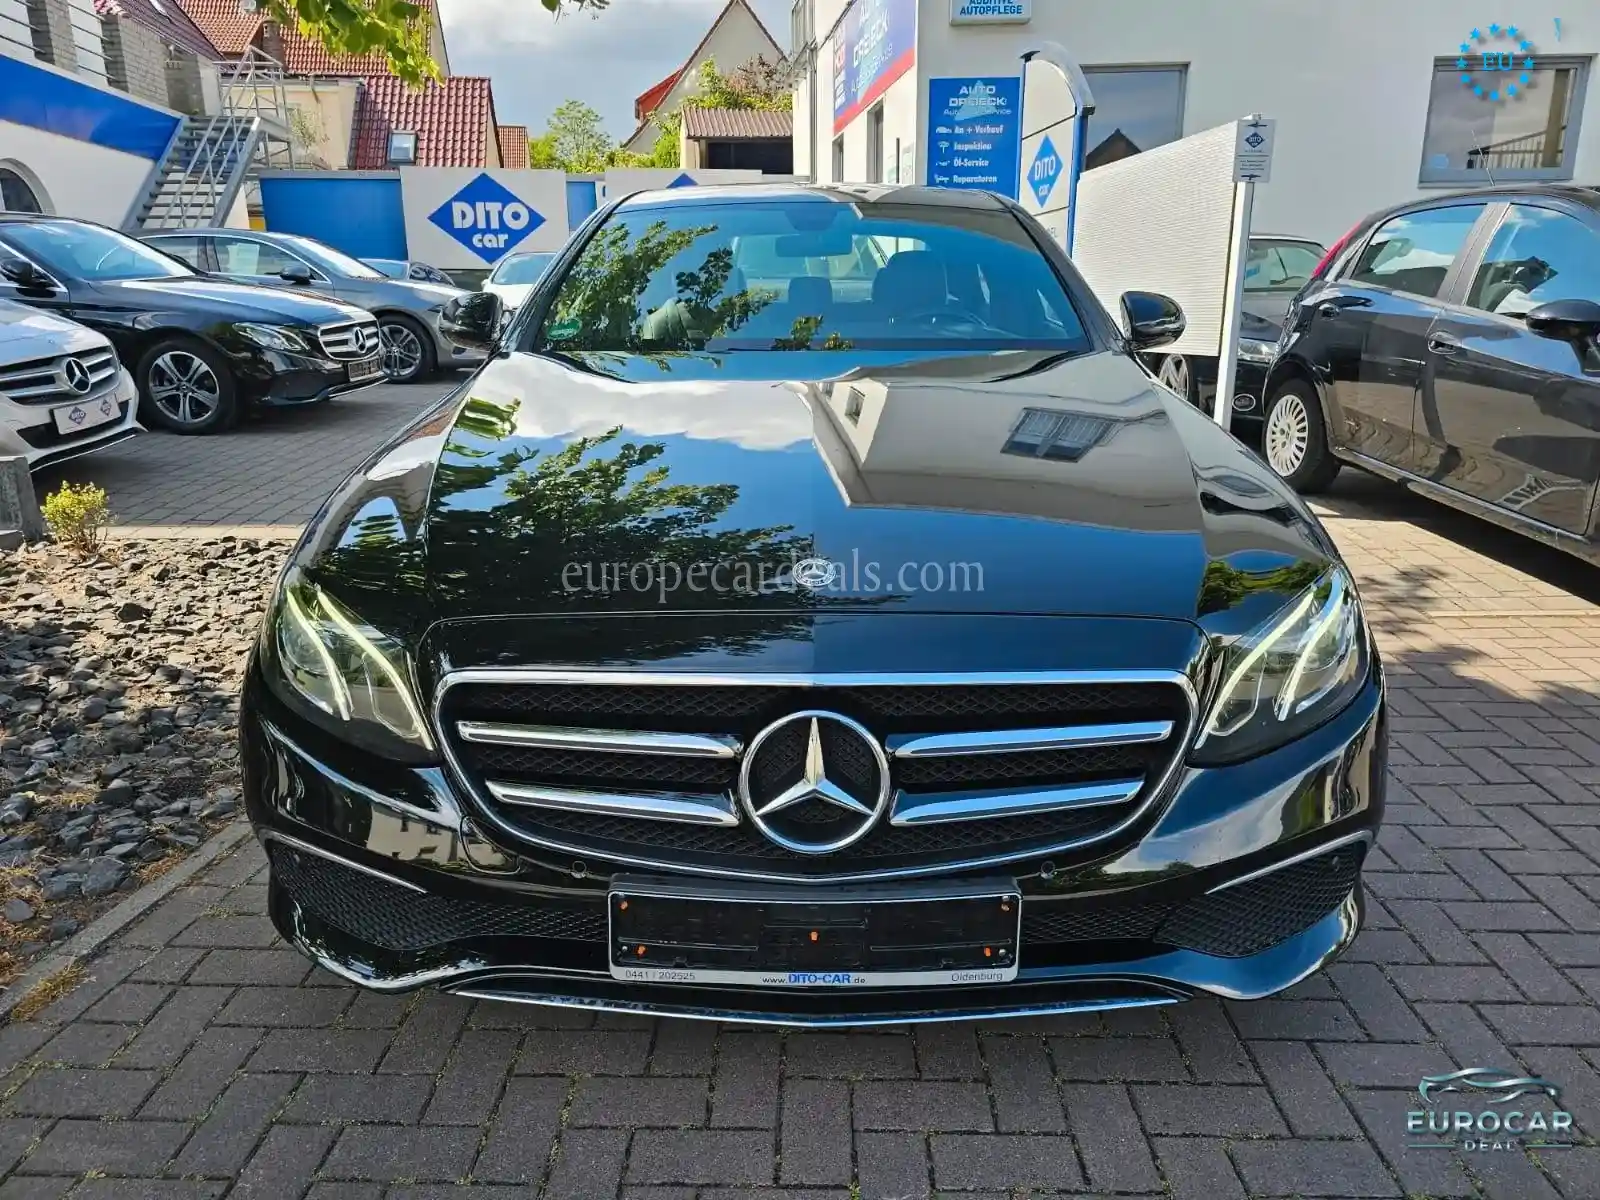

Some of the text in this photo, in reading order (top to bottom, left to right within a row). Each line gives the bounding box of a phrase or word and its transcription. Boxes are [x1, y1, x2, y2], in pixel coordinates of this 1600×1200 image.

[959, 5, 1023, 16] AUTOPFLEGE
[959, 85, 996, 95] AUTO
[953, 141, 992, 152] Inspektion
[953, 157, 989, 168] Öl-Service
[1034, 156, 1055, 181] DITO
[452, 201, 530, 230] DITO
[472, 233, 509, 248] car
[951, 971, 1003, 982] Oldenburg
